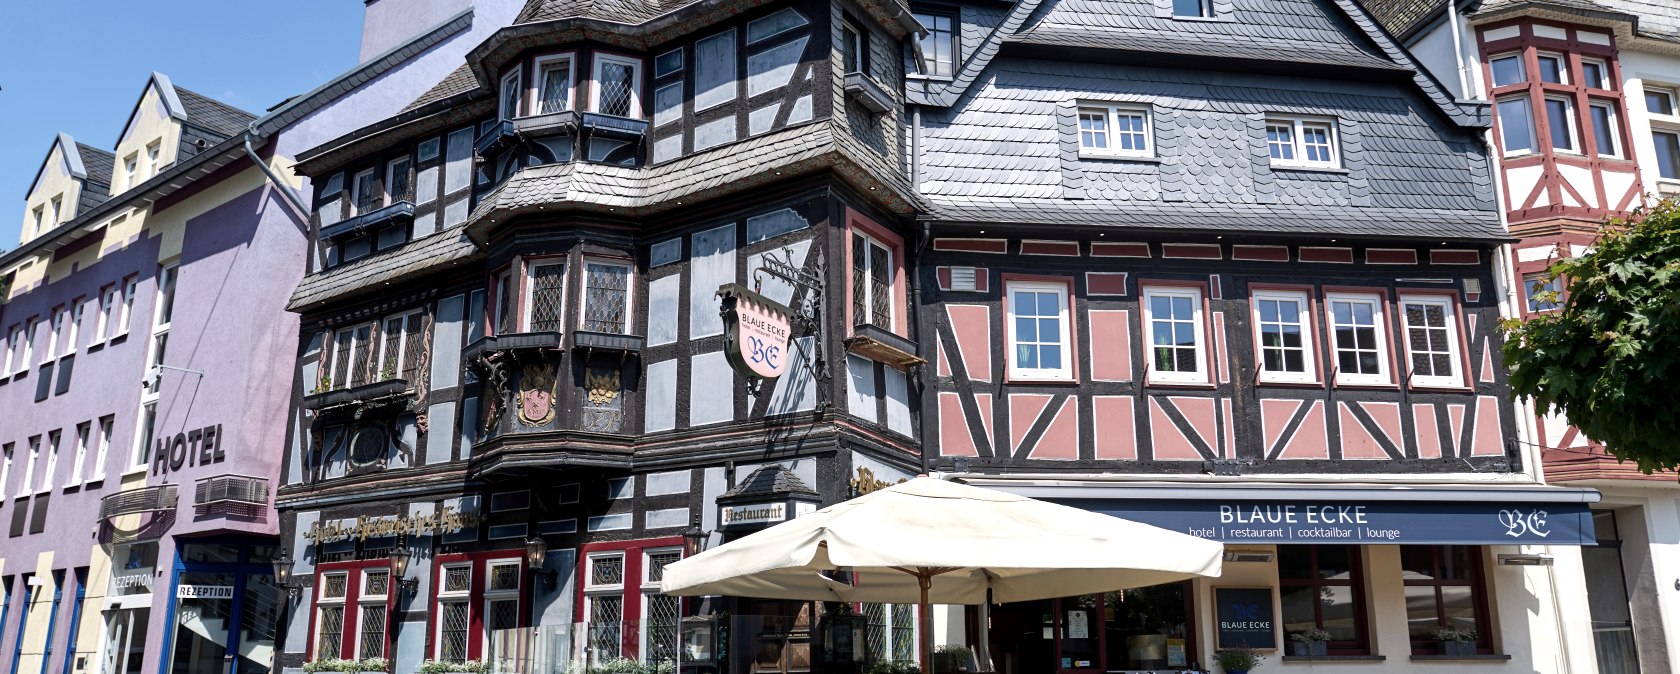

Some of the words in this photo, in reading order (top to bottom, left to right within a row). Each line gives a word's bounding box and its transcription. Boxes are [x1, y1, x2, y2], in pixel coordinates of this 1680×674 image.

[742, 313, 766, 330] BLAUE
[767, 323, 786, 338] ECKE
[153, 423, 226, 477] HOTEL
[724, 504, 783, 523] Restaurant
[1219, 505, 1298, 524] BLAUE
[1306, 505, 1368, 524] ECKE
[1189, 526, 1215, 538] hotel
[1230, 527, 1283, 538] restaurant
[1297, 527, 1352, 538] cocktailbar
[1366, 527, 1400, 540] lounge
[179, 586, 232, 598] REZEPTION
[1221, 621, 1247, 629] BLAUE
[1249, 621, 1270, 629] ECKE
